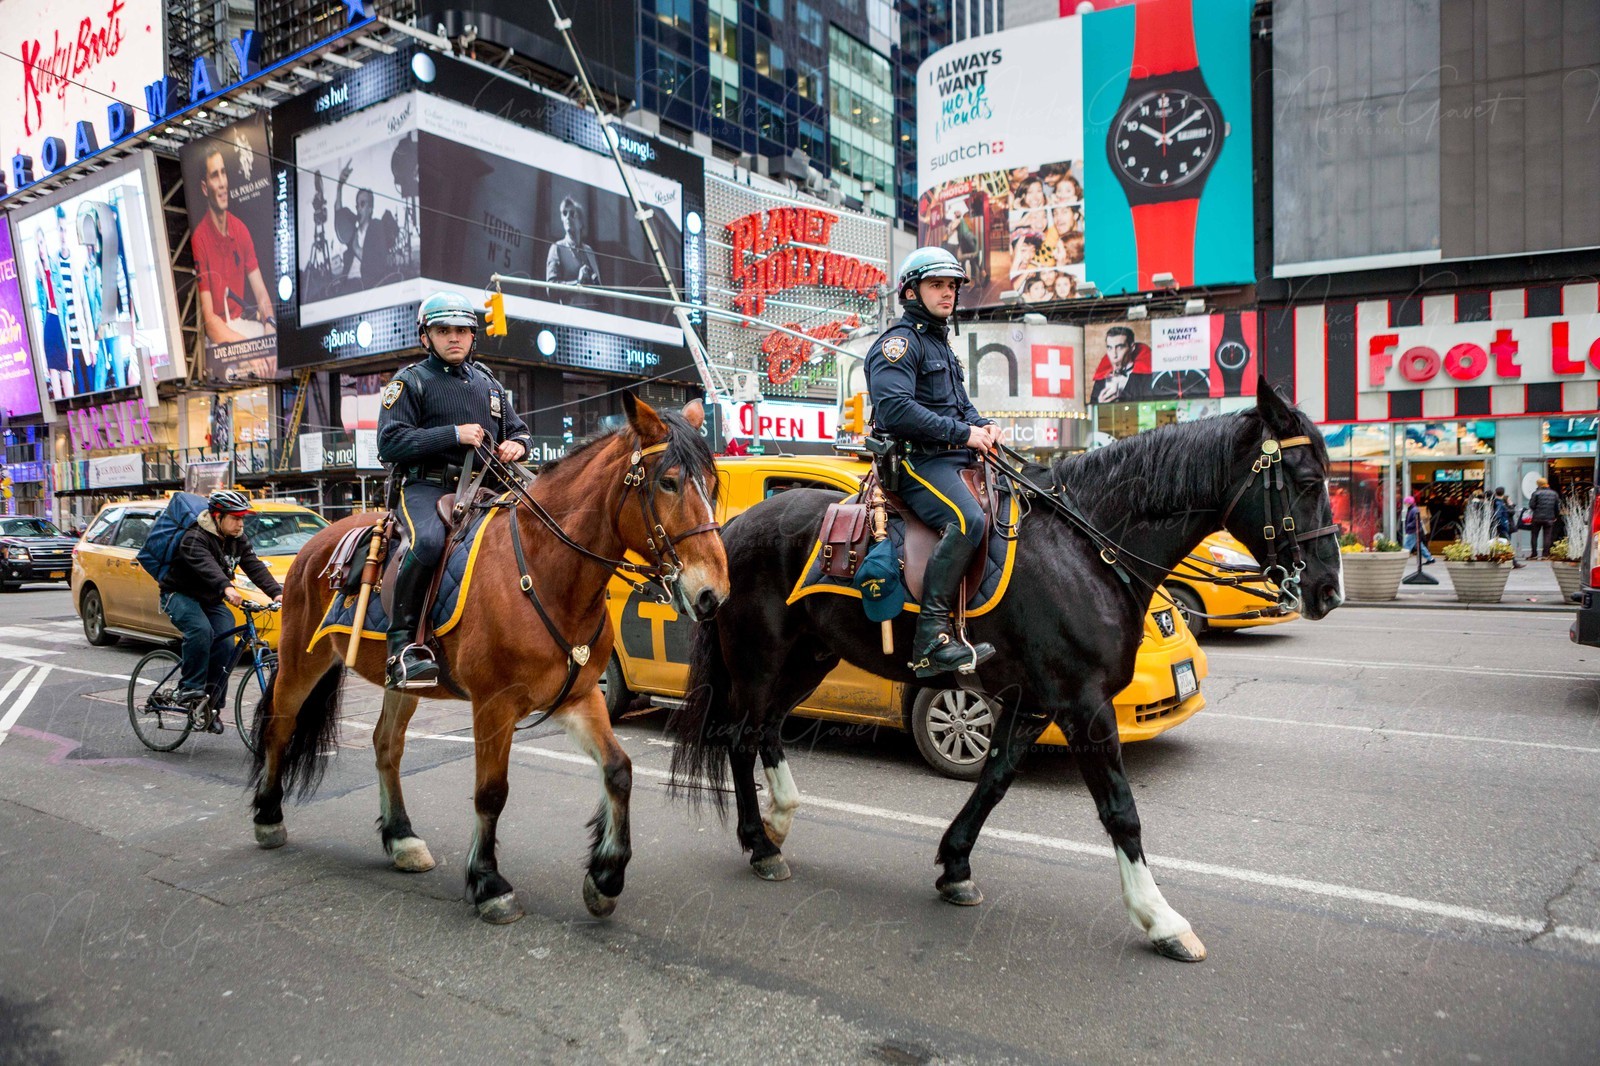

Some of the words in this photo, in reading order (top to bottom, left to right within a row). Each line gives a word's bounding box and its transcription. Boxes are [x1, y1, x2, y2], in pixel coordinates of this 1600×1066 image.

[21, 29, 73, 137] Kinky
[72, 0, 126, 78] Boots
[937, 49, 1002, 82] ALWAYS
[331, 82, 348, 107] hut
[938, 70, 988, 98] WANT
[0, 29, 258, 200] ROADWAY
[943, 84, 988, 118] more
[1141, 105, 1150, 117] 11
[1158, 97, 1170, 108] 12
[1126, 120, 1139, 132] 10
[930, 141, 990, 172] swatch
[1120, 139, 1130, 151] 9
[1192, 146, 1201, 157] 4
[1141, 167, 1150, 178] 7
[1160, 169, 1169, 181] 6
[1179, 162, 1188, 173] 5
[277, 169, 288, 201] hut
[279, 201, 291, 275] sunglass
[483, 209, 521, 249] TEATRO
[503, 248, 512, 269] 5
[725, 206, 839, 282] PLANET
[690, 234, 701, 298] sunglass
[1167, 326, 1198, 335] ALWAYS
[1168, 334, 1192, 342] WANT
[213, 346, 229, 360] LIVE
[227, 334, 278, 357] AUTHENTICALLY
[1369, 328, 1522, 387] Foot
[1552, 320, 1600, 376] L
[67, 398, 154, 455] FOREVER
[739, 403, 805, 439] OPEN
[637, 601, 679, 662] T
